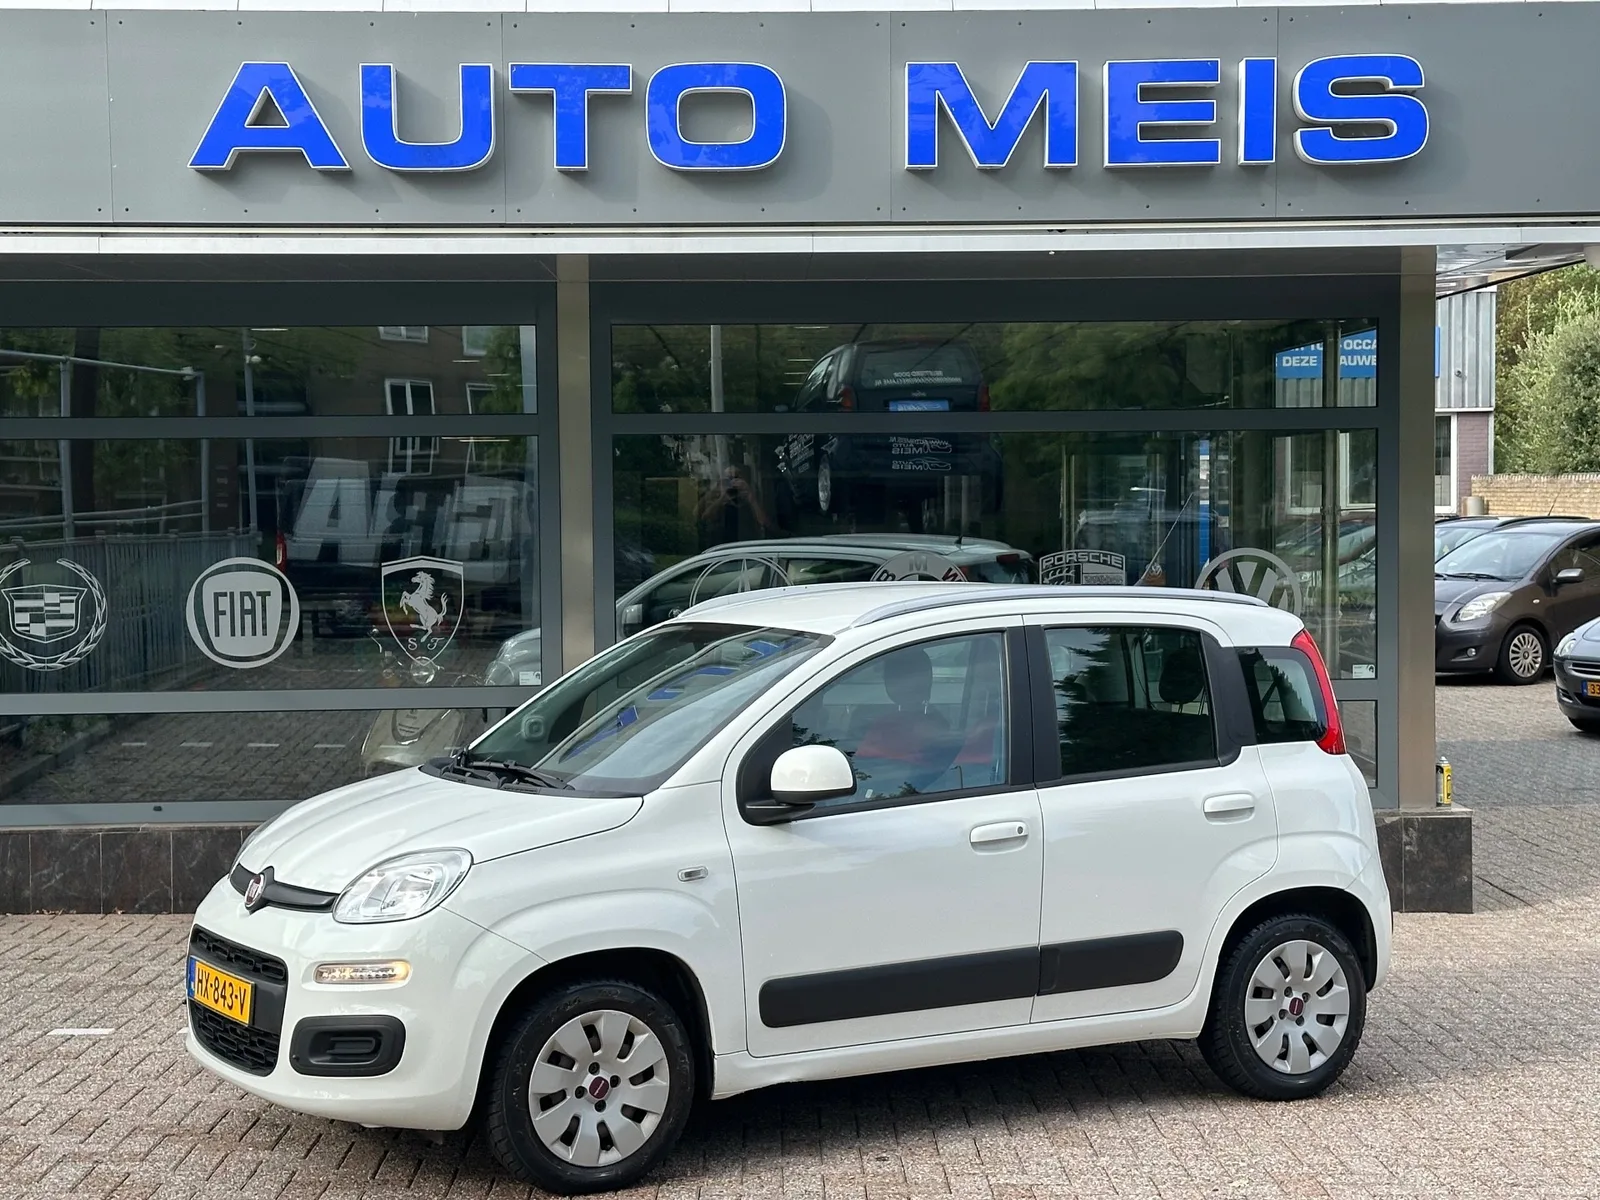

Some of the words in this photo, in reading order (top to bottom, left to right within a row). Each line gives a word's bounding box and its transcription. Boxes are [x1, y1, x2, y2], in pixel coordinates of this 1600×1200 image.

[186, 61, 787, 172] AUTO
[904, 53, 1429, 169] MEIS
[1282, 356, 1318, 367] DEZE
[1042, 552, 1123, 570] PORSCHE
[213, 590, 271, 638] FIAT
[196, 966, 247, 1016] HX-843-V
